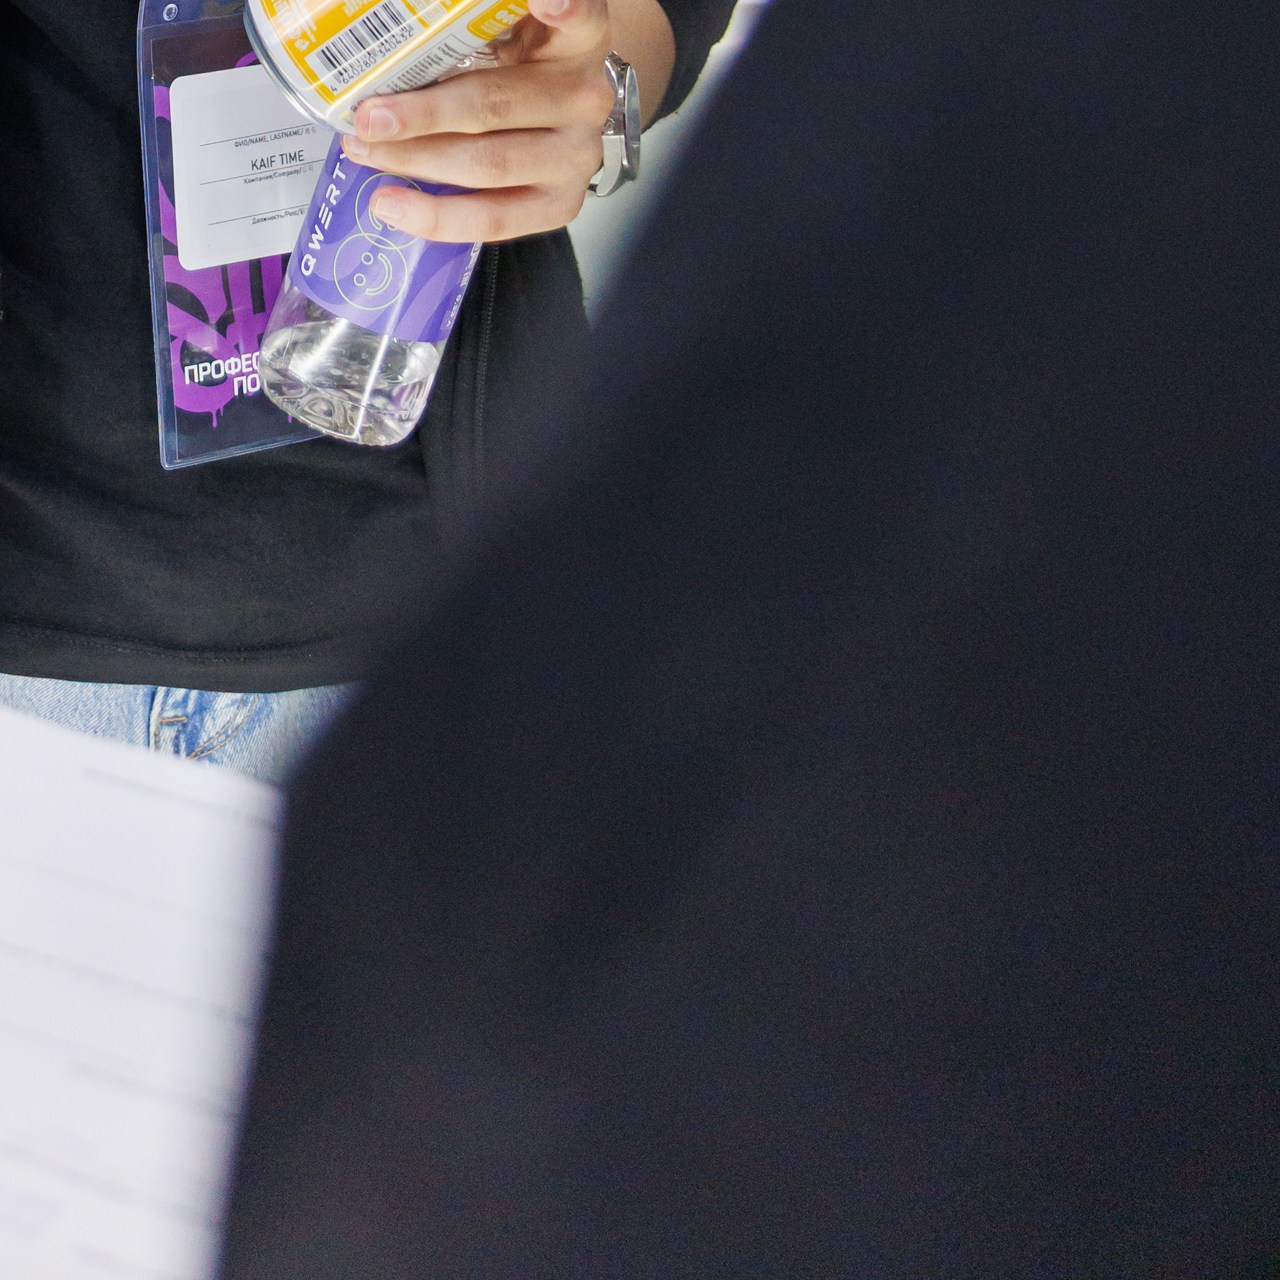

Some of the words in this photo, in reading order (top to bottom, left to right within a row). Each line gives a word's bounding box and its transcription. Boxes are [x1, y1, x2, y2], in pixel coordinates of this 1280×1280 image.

[251, 155, 277, 172] KAIF
[278, 149, 305, 166] TIME
[184, 351, 261, 385] ПРОФЕС
[233, 373, 261, 396] ПО
